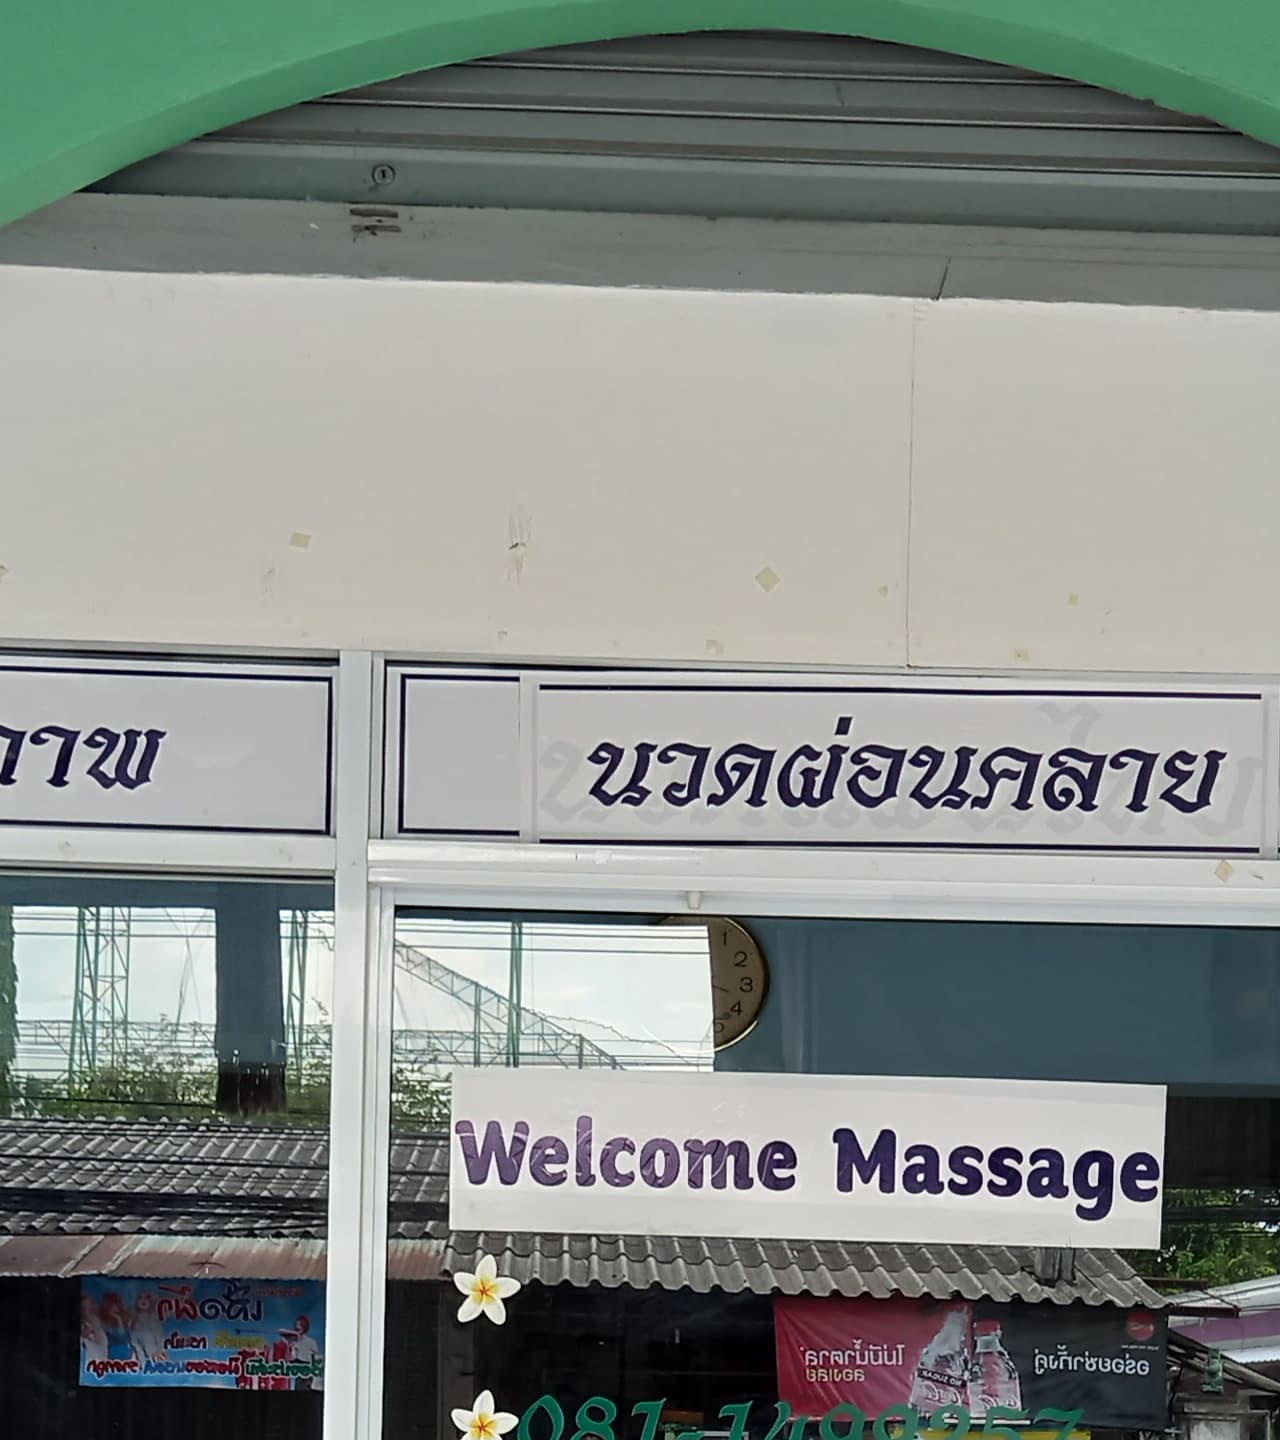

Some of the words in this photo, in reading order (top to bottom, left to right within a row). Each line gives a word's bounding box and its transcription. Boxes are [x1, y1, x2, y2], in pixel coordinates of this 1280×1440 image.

[588, 717, 1227, 813] นวดผ่อนคลาย
[455, 1116, 797, 1191] Welcome
[833, 1129, 1161, 1222] Massage
